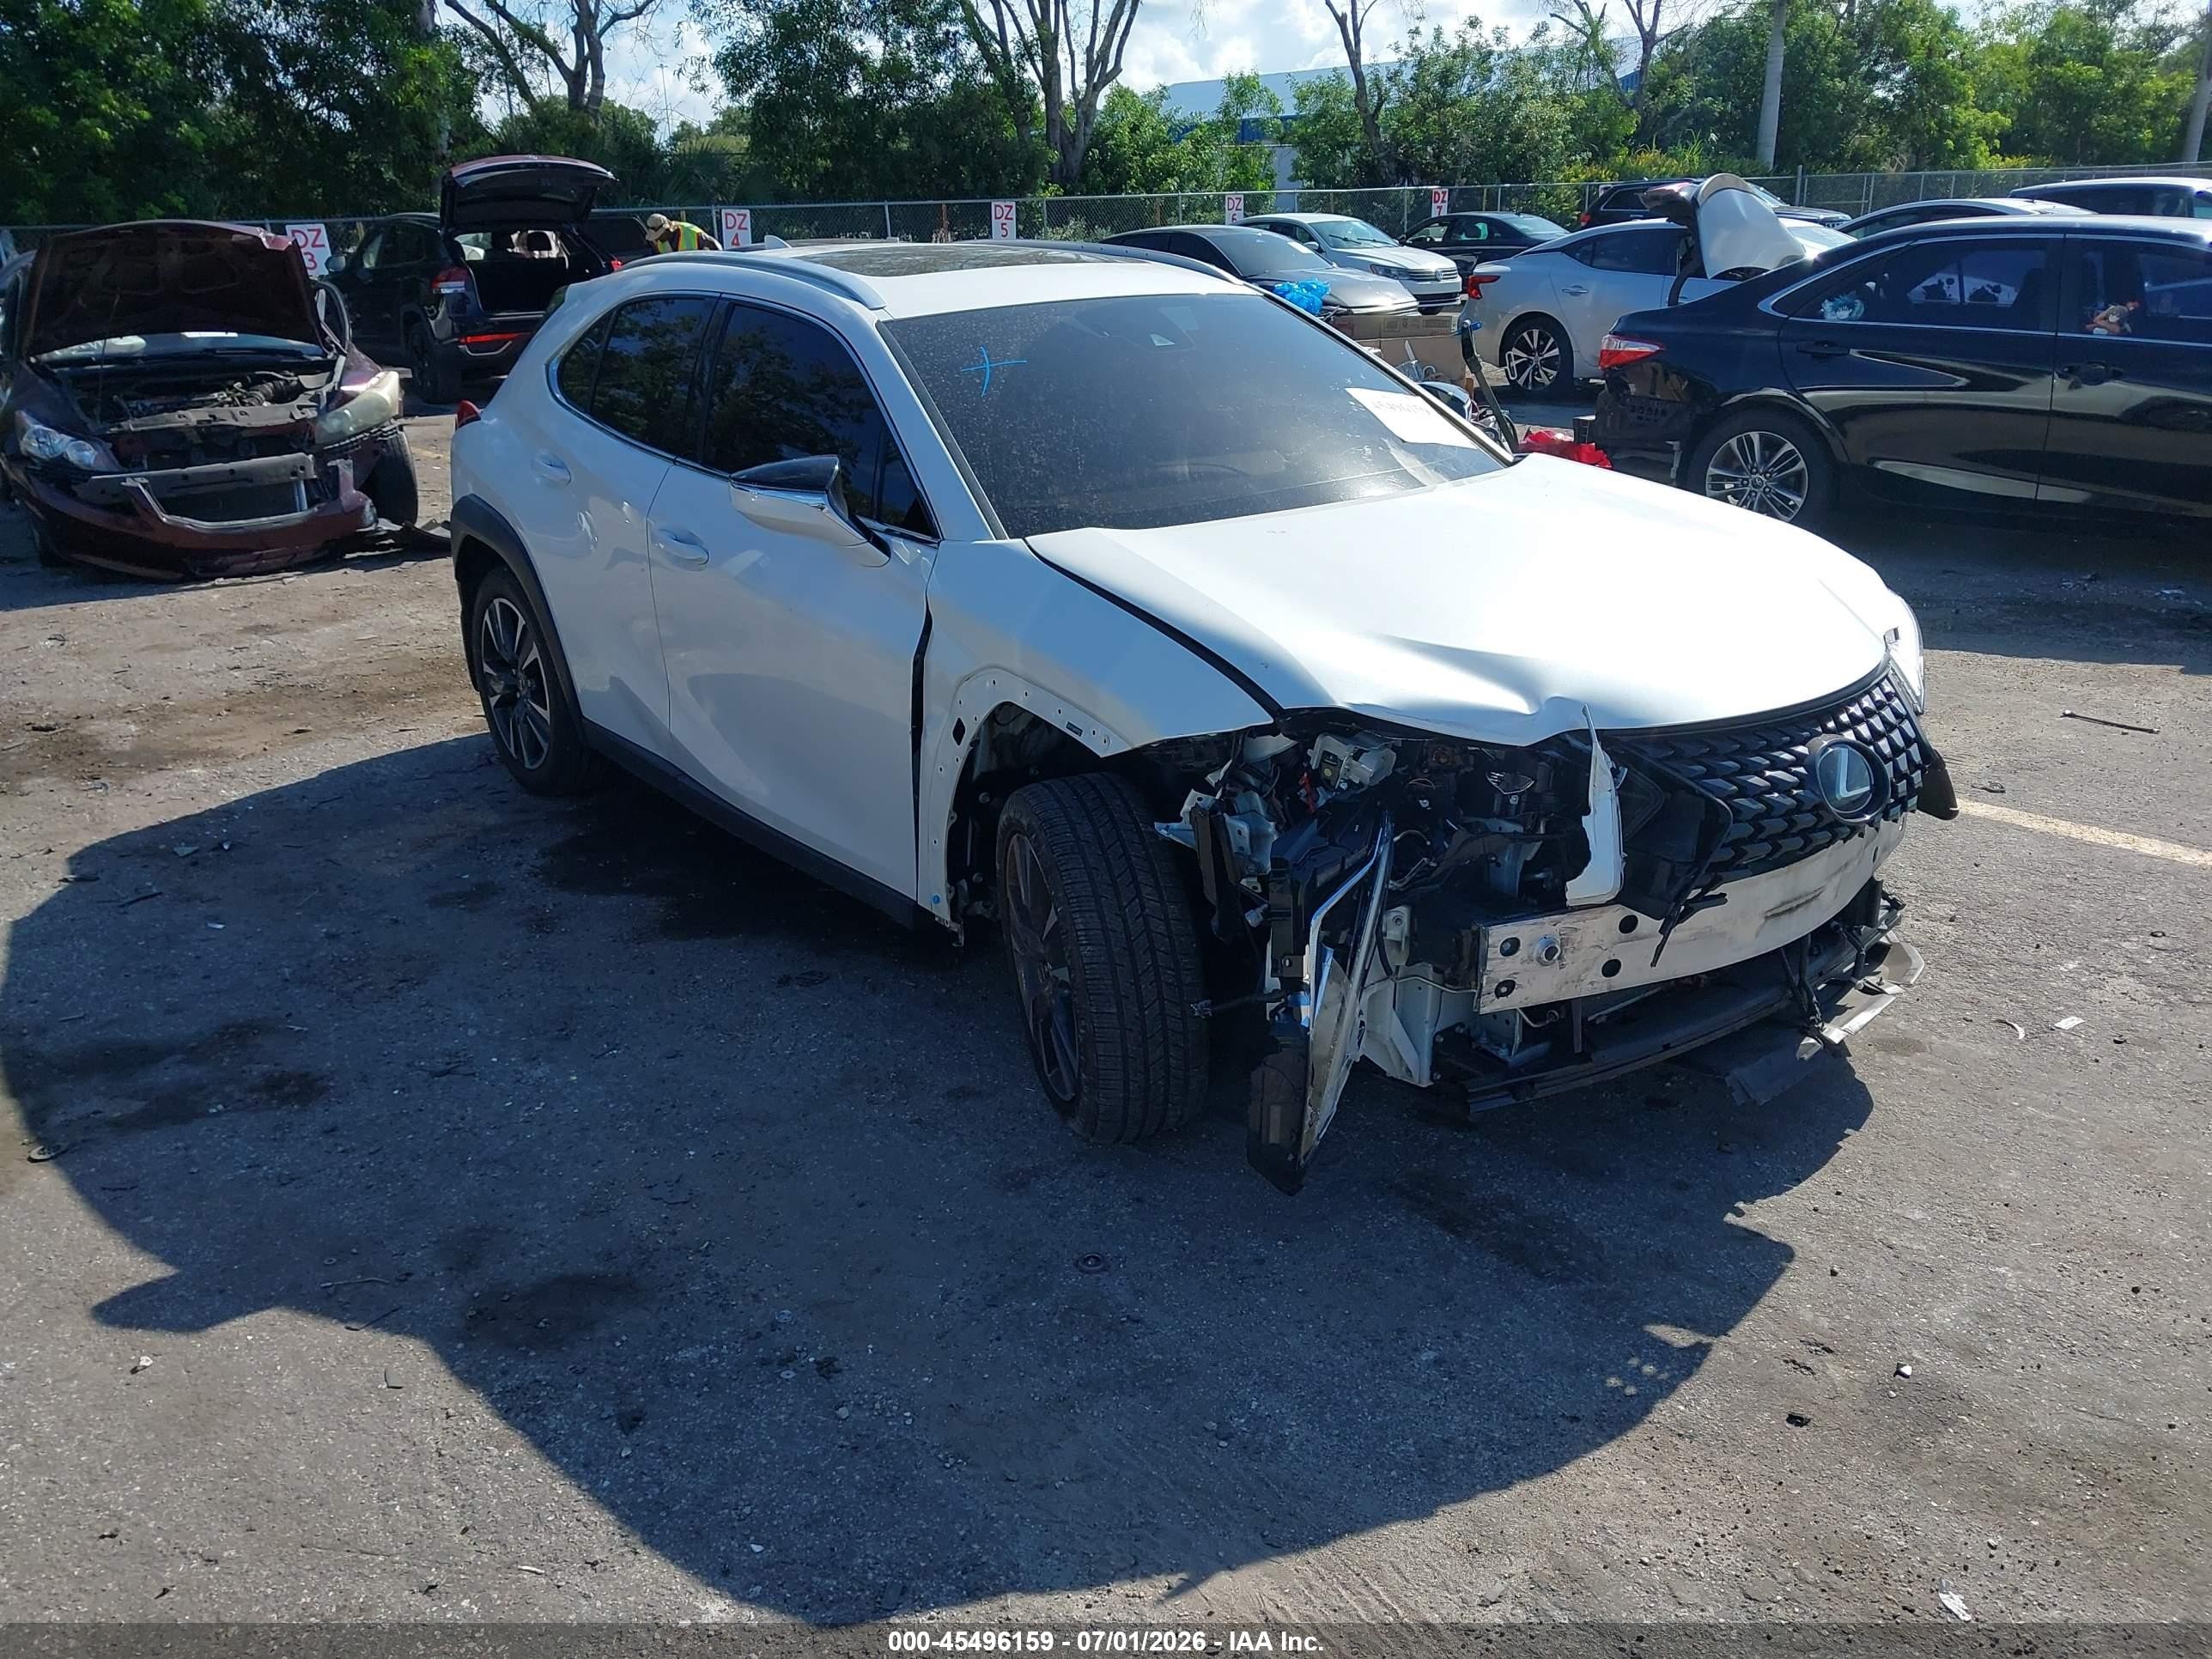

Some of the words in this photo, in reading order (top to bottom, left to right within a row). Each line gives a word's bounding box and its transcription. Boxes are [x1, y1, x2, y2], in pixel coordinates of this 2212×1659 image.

[1228, 198, 1242, 211] DZ
[1433, 191, 1447, 204] DZ
[725, 212, 748, 230] DZ
[994, 204, 1014, 221] DZ
[290, 228, 325, 248] DZ
[1000, 222, 1008, 238] 5
[303, 252, 318, 270] 3
